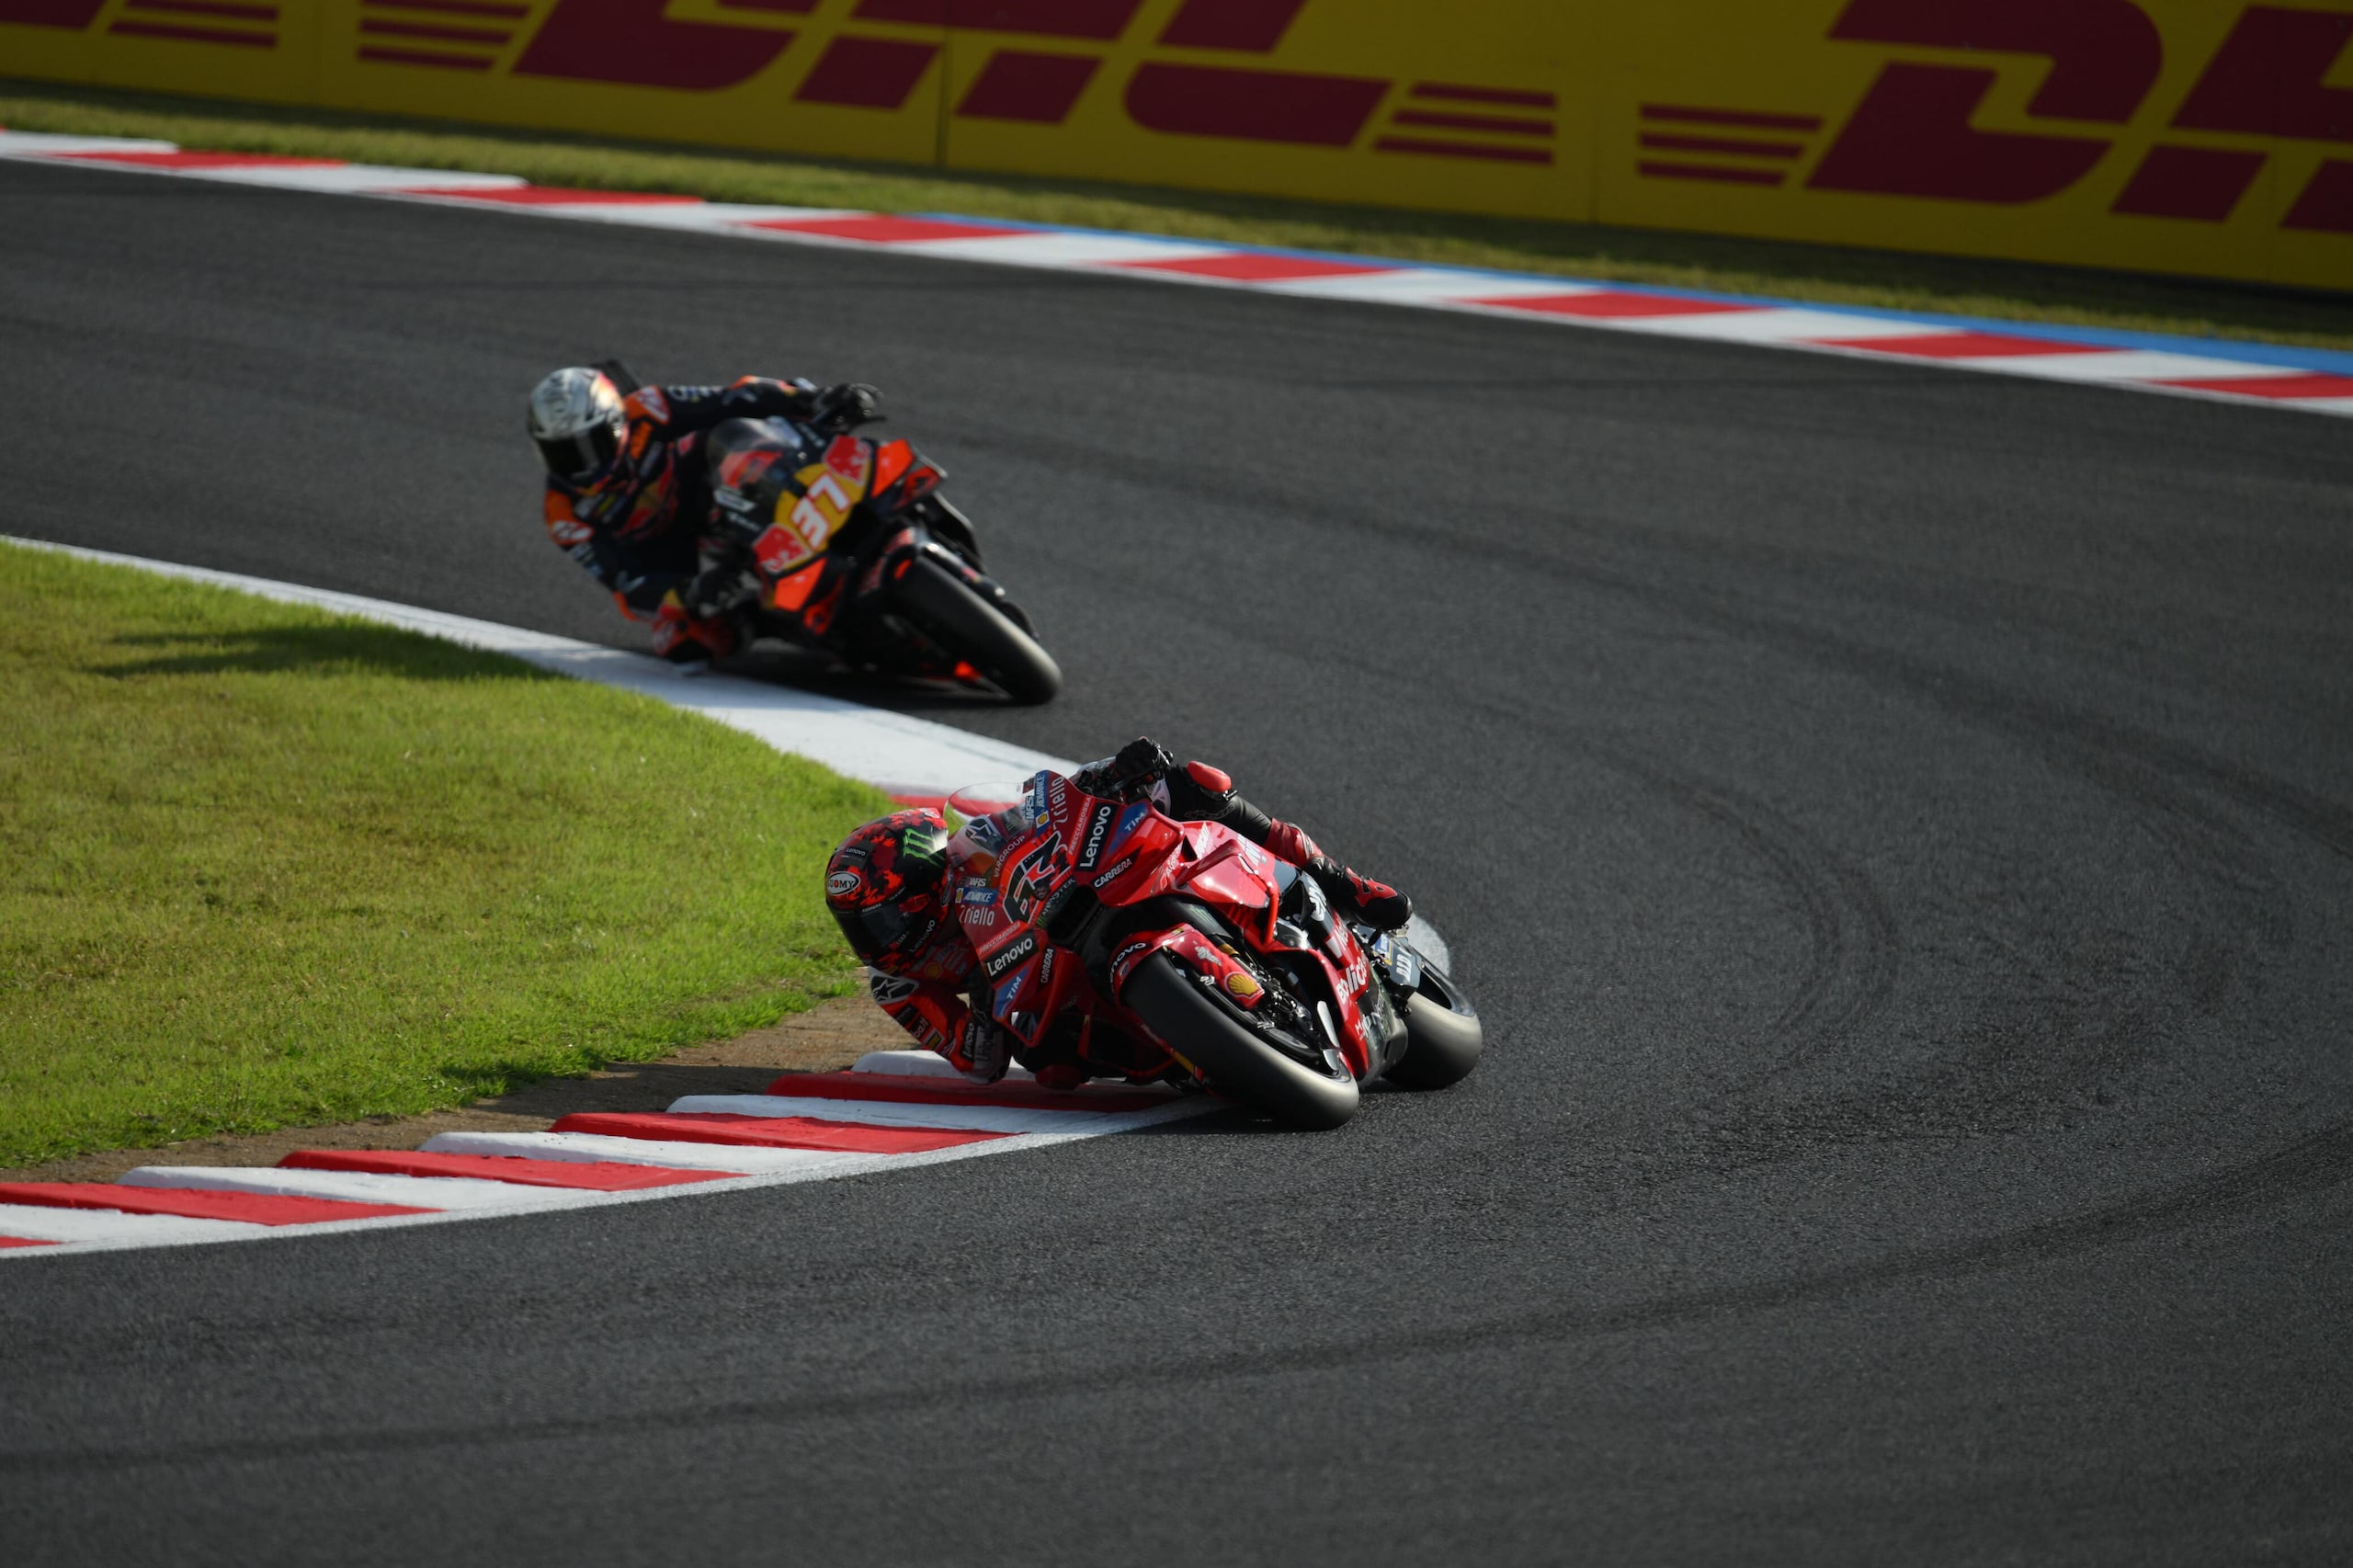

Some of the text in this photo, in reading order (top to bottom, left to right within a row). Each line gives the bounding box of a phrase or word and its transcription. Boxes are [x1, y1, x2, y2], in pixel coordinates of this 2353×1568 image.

[790, 471, 851, 550] 37
[1068, 797, 1092, 855] FRECCIAROSSA
[1079, 806, 1111, 868] Lenovo
[1125, 812, 1145, 832] TIM
[846, 846, 866, 857] Lenovo
[970, 877, 987, 887] WRS
[1094, 858, 1132, 888] CARRERA
[987, 937, 1033, 977] Lenovo
[1040, 948, 1054, 983] CARRERA
[1109, 942, 1147, 994] novo
[1006, 976, 1022, 999] TIM
